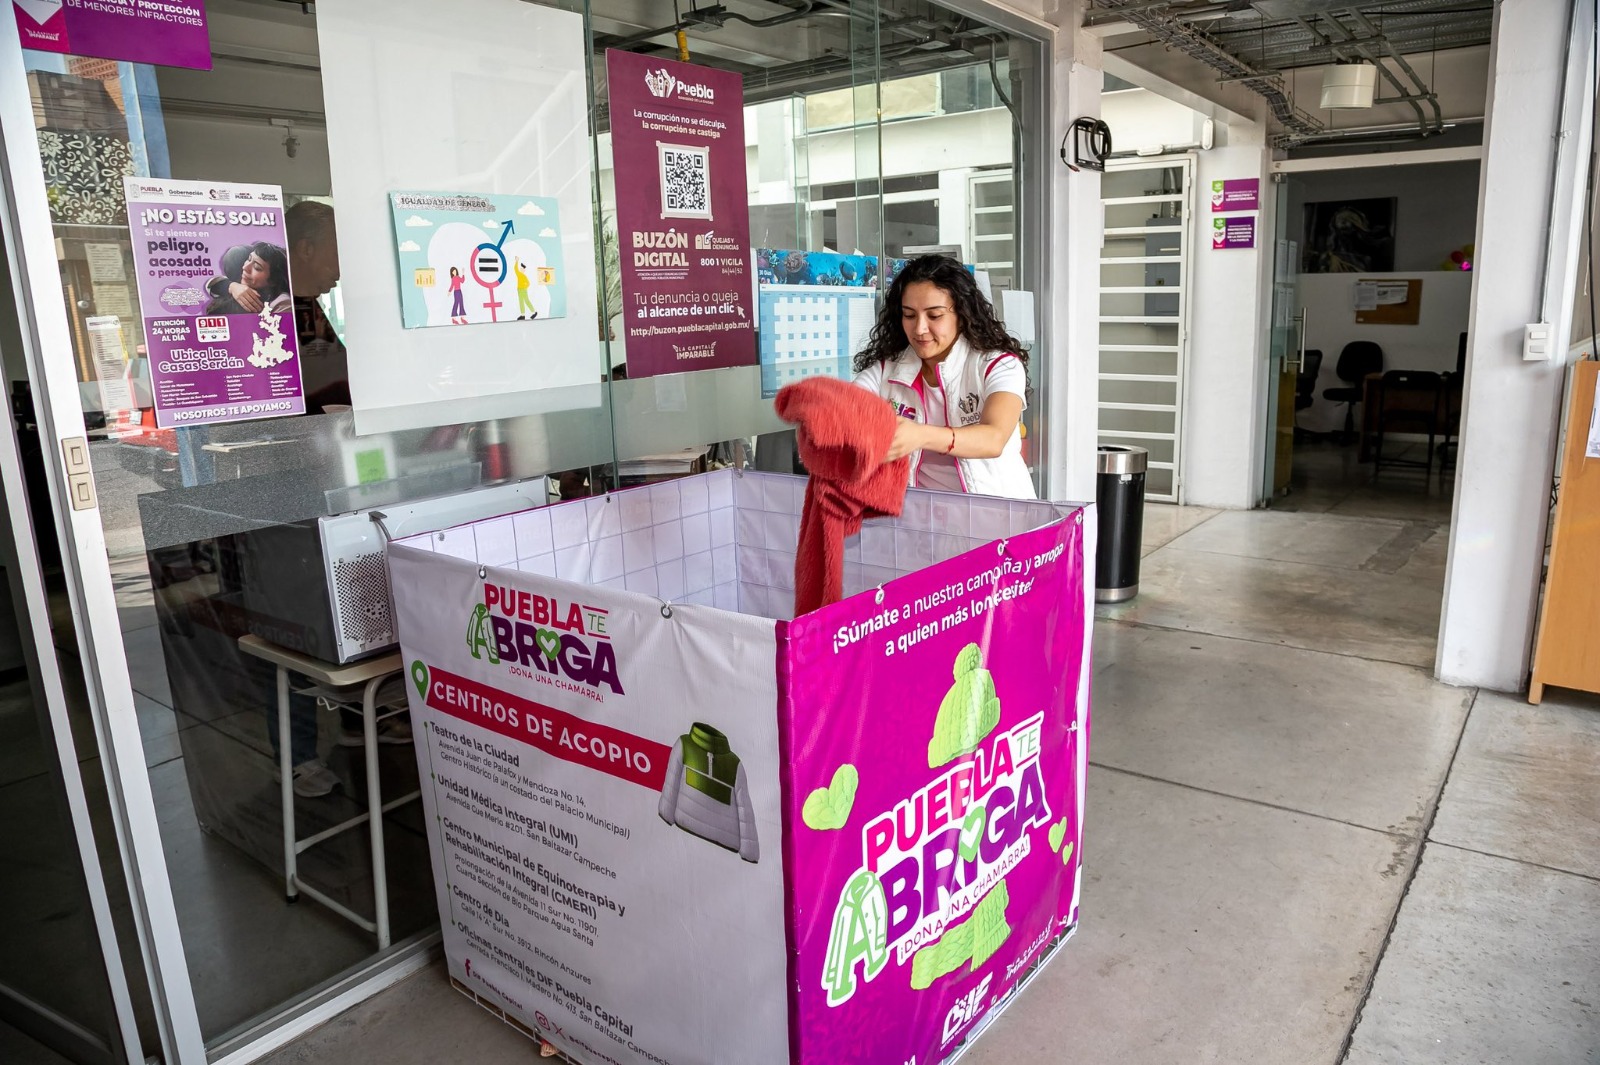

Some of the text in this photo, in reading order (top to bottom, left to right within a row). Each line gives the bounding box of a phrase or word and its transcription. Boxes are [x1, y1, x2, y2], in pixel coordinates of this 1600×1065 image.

[67, 0, 204, 27] DE MENORES INFRACTORES
[138, 0, 201, 17] PROTECCIÓN
[677, 80, 714, 99] Puebla
[633, 109, 642, 118] La
[643, 111, 680, 123] corrupción
[691, 118, 698, 126] se
[642, 120, 721, 139] la corrupción se castiga
[141, 207, 277, 227] ¡NO ESTÁS SOLA!
[145, 229, 153, 237] Si
[155, 229, 165, 237] te
[167, 230, 198, 238] sientes
[632, 228, 689, 249] BUZÓN
[712, 237, 731, 245] QUEJAS
[147, 237, 209, 255] peligro,
[149, 255, 212, 267] acosada
[634, 252, 690, 267] DIGITAL
[700, 258, 744, 266] 800 VIGILA
[158, 268, 214, 278] perseguida
[634, 290, 739, 305] Tu denuncia o queja
[637, 302, 735, 319] al alcance de un clic
[153, 318, 186, 327] ATENCIÓN
[164, 326, 191, 335] HORAS
[631, 320, 751, 338] http://buzon.pueblacapital.gob.mx/
[172, 333, 186, 342] DÍA
[171, 347, 227, 361] Ubica las
[676, 349, 715, 360] IMPARABLE
[159, 357, 245, 373] Casas Serdán
[174, 402, 292, 421] NOSOTROS TE APOYAMOS
[833, 543, 1064, 654] ¡Súmate a nuestra campiña y arropa
[484, 583, 607, 636] PUEBLA TE
[885, 606, 969, 657] a quien más
[467, 603, 625, 696] ABRIGA
[508, 665, 604, 704] ¡DONA UNA CHAMARRA!
[433, 681, 652, 774] CENTROS DE ACOPIO
[430, 721, 520, 767] Teatro de la Ciudad
[438, 740, 574, 803] Avenida Juan de Palafox y Mendoza No.
[440, 751, 630, 841] Centro Histórico un costado del Palacio Municipal)
[866, 728, 1038, 873] PUEBLA TE
[437, 773, 578, 849] Unidad Médica Integral (UMI)
[446, 792, 471, 811] Avenida
[526, 829, 541, 843] San
[542, 836, 573, 858] Baltazar
[573, 851, 617, 880] Campeche
[443, 816, 626, 918] Centro Municipal de Equinoterapia y
[445, 831, 597, 920] Rehabilitación Integral (CMERI)
[454, 853, 577, 925] Prolongación de la Avenida Sur No.
[823, 761, 1047, 1003] ABRIGA
[453, 884, 494, 918] Centro de
[455, 864, 594, 948] Cuarta Sección de Bio Parque Agua Santa
[900, 839, 1029, 960] ¡DONA CHAMARRA!
[492, 922, 504, 935] Sur
[534, 946, 559, 967] Rincón
[560, 962, 592, 985] Anzures
[457, 921, 633, 1038] Oficinas centrales DIF Puebla Capital
[466, 938, 490, 959] Cerrada
[490, 953, 520, 978] Francisco
[525, 976, 552, 998] Madero
[579, 1010, 593, 1026] San
[594, 1020, 626, 1045] Baltazar
[627, 1041, 674, 1065] Campech
[502, 992, 523, 1011] Capital
